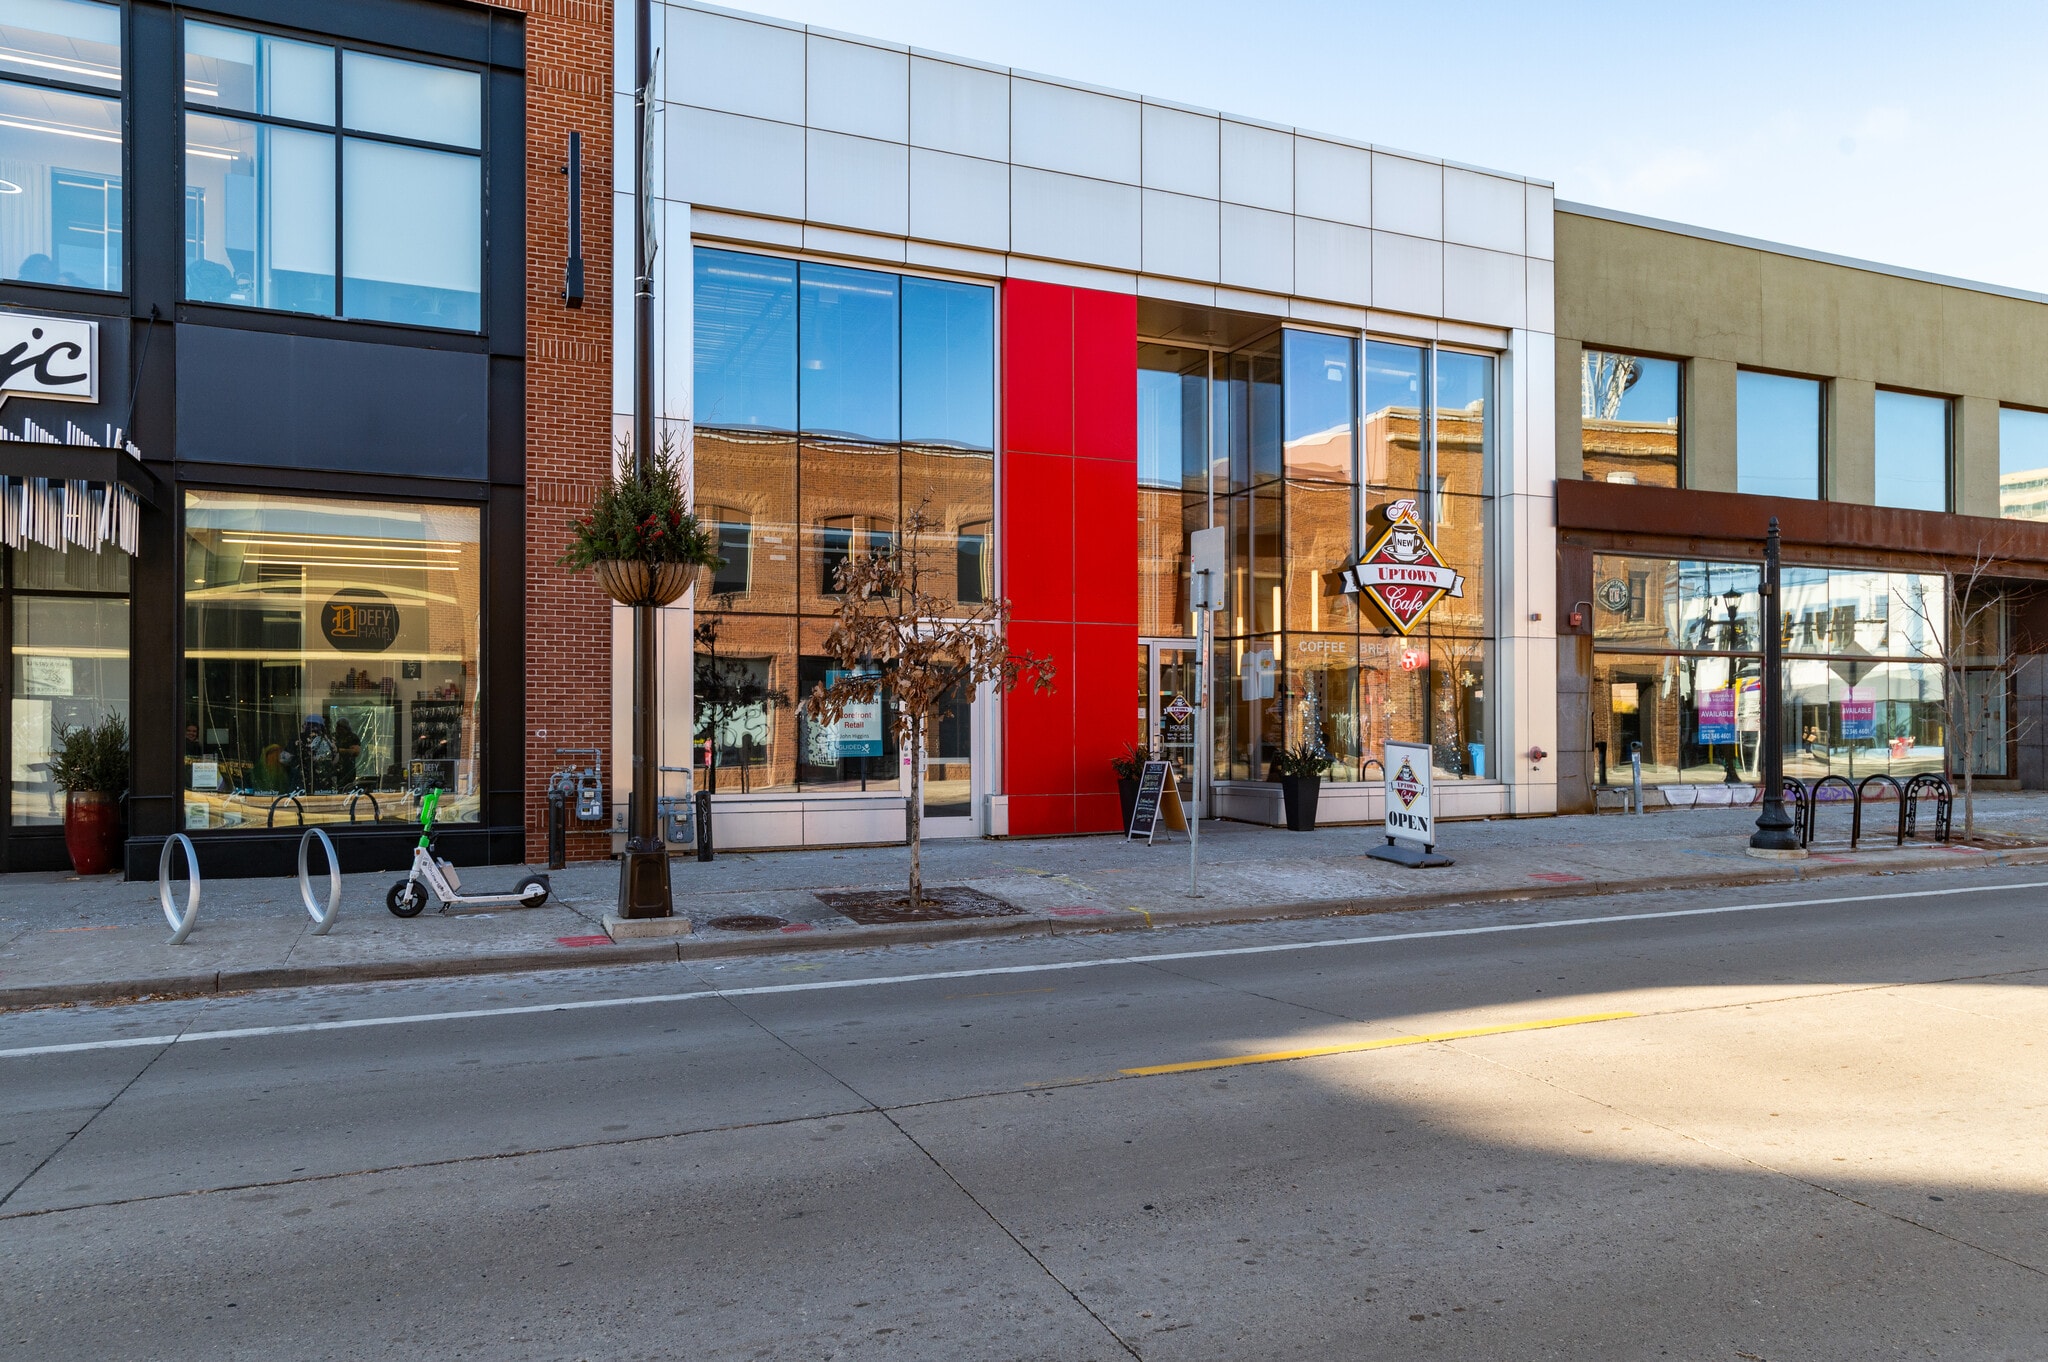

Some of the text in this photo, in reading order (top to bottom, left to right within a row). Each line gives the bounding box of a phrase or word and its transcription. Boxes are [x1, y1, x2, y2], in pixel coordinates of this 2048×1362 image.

[1387, 500, 1417, 520] The
[1398, 538, 1413, 547] NEW
[1378, 567, 1437, 583] UPTOWN
[1386, 586, 1423, 619] Cafe
[359, 609, 391, 626] DEFY
[359, 627, 391, 638] HAIR
[1299, 641, 1346, 653] COFFEE
[1445, 645, 1483, 657] LUNCH
[1397, 782, 1417, 790] UPTOWN
[1389, 811, 1429, 832] OPEN
